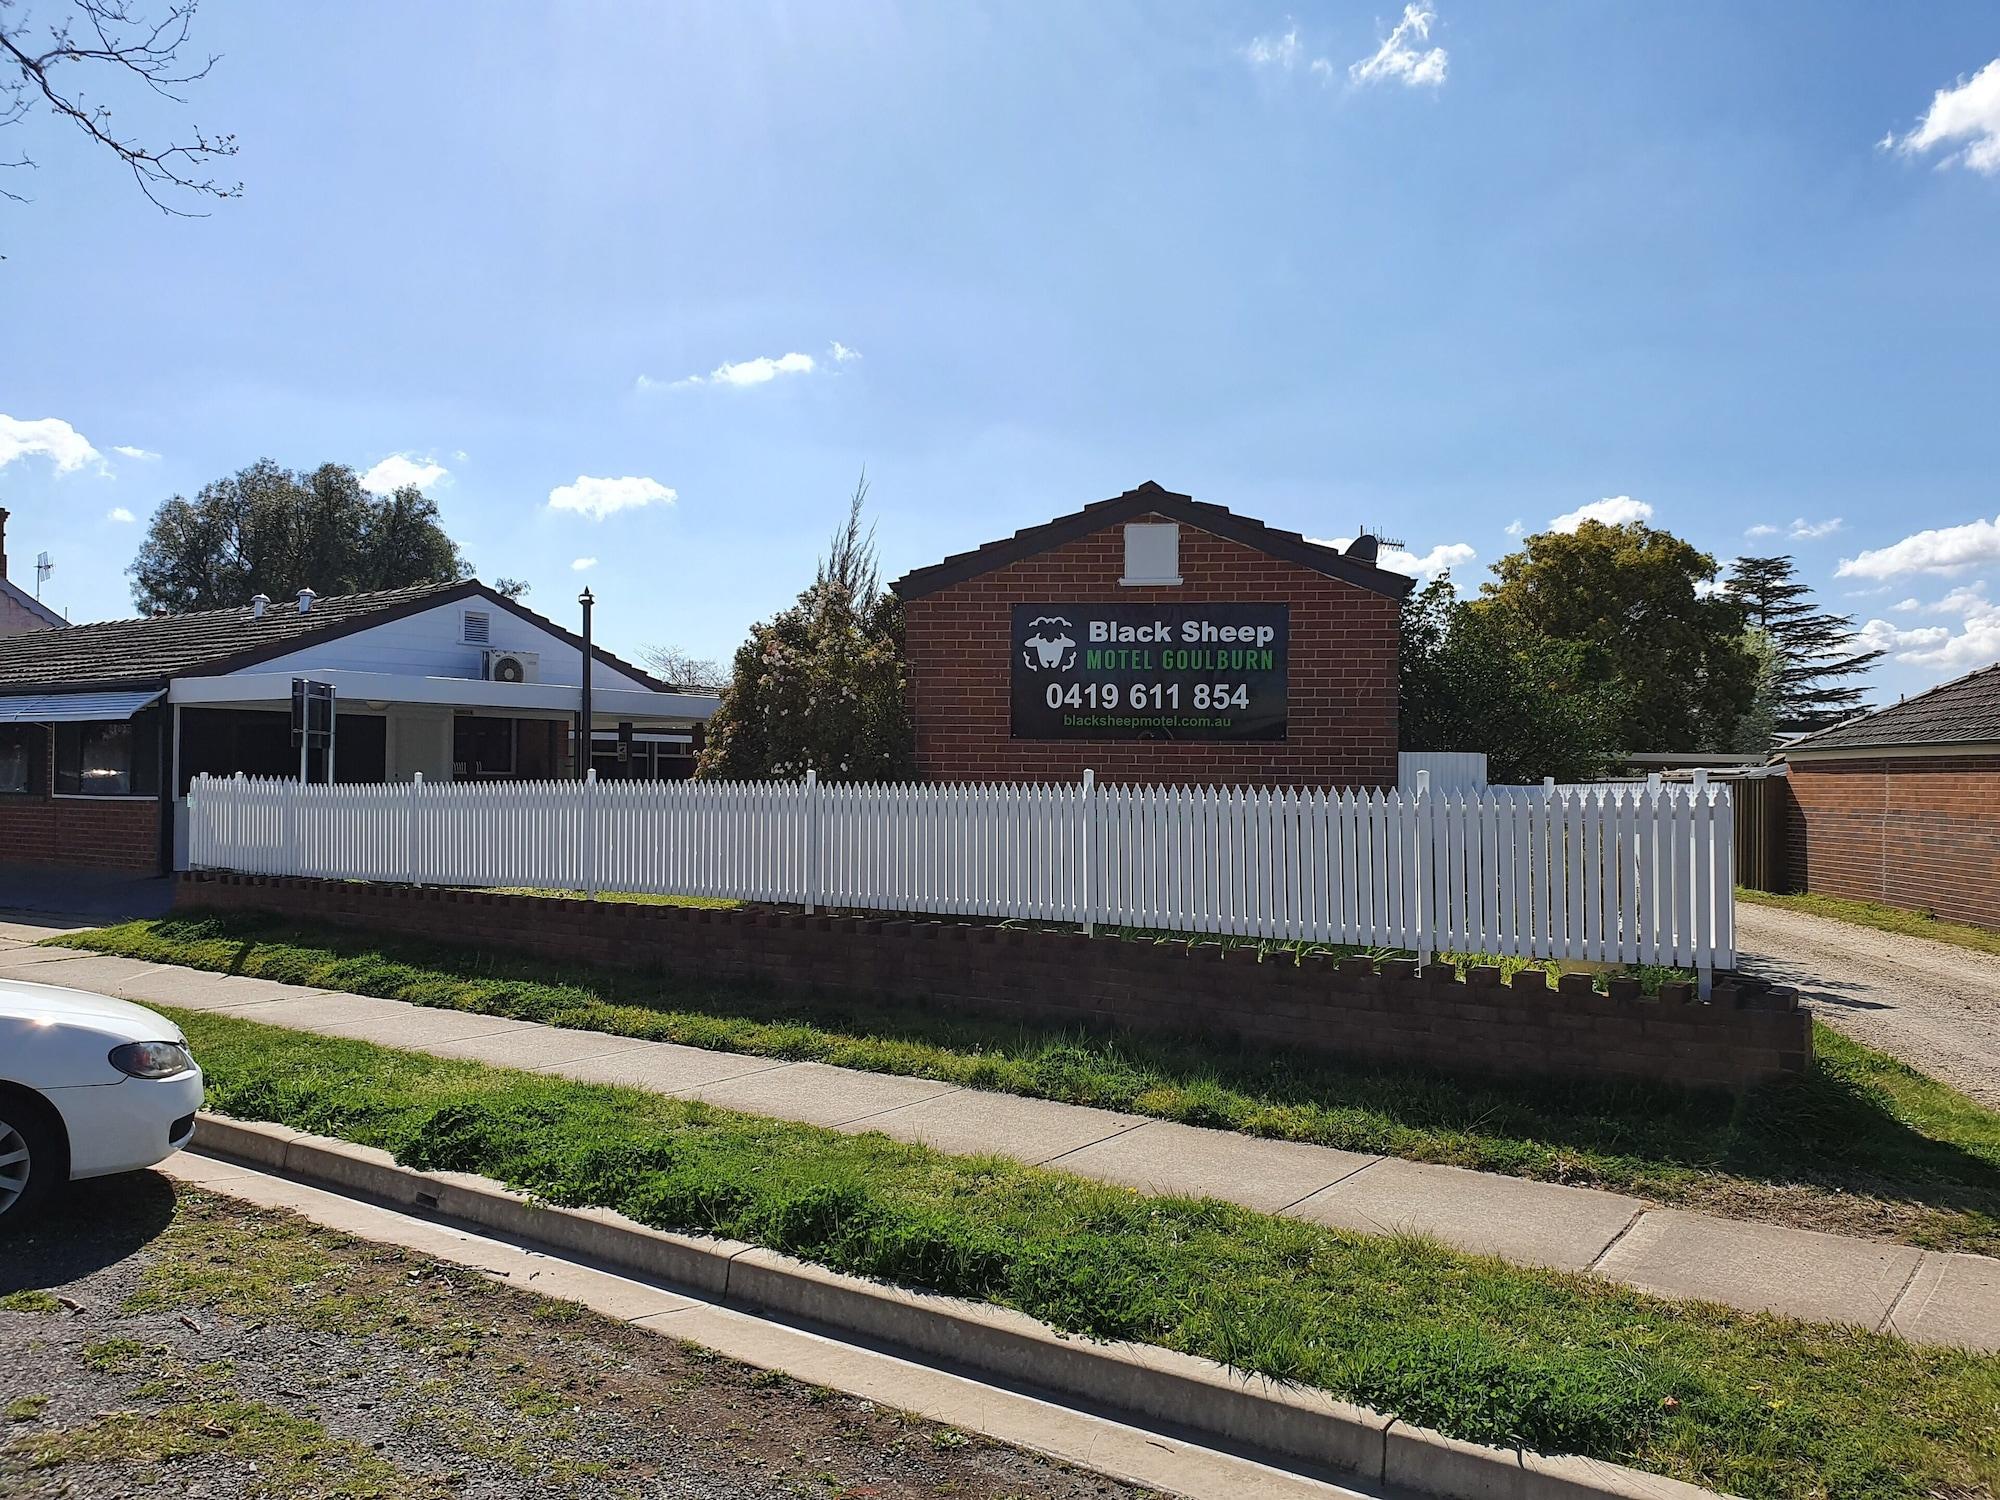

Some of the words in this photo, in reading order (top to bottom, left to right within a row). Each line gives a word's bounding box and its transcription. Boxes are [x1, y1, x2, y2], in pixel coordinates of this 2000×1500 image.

[1089, 621, 1172, 643] Black
[1181, 620, 1275, 648] Sheep
[1086, 650, 1153, 670] MOTEL
[1162, 650, 1274, 670] GOULBURN
[1045, 683, 1119, 710] 0419
[1129, 683, 1180, 710] 611
[1193, 683, 1250, 710] 854
[1063, 714, 1232, 729] blacksheepmotel.com.au
